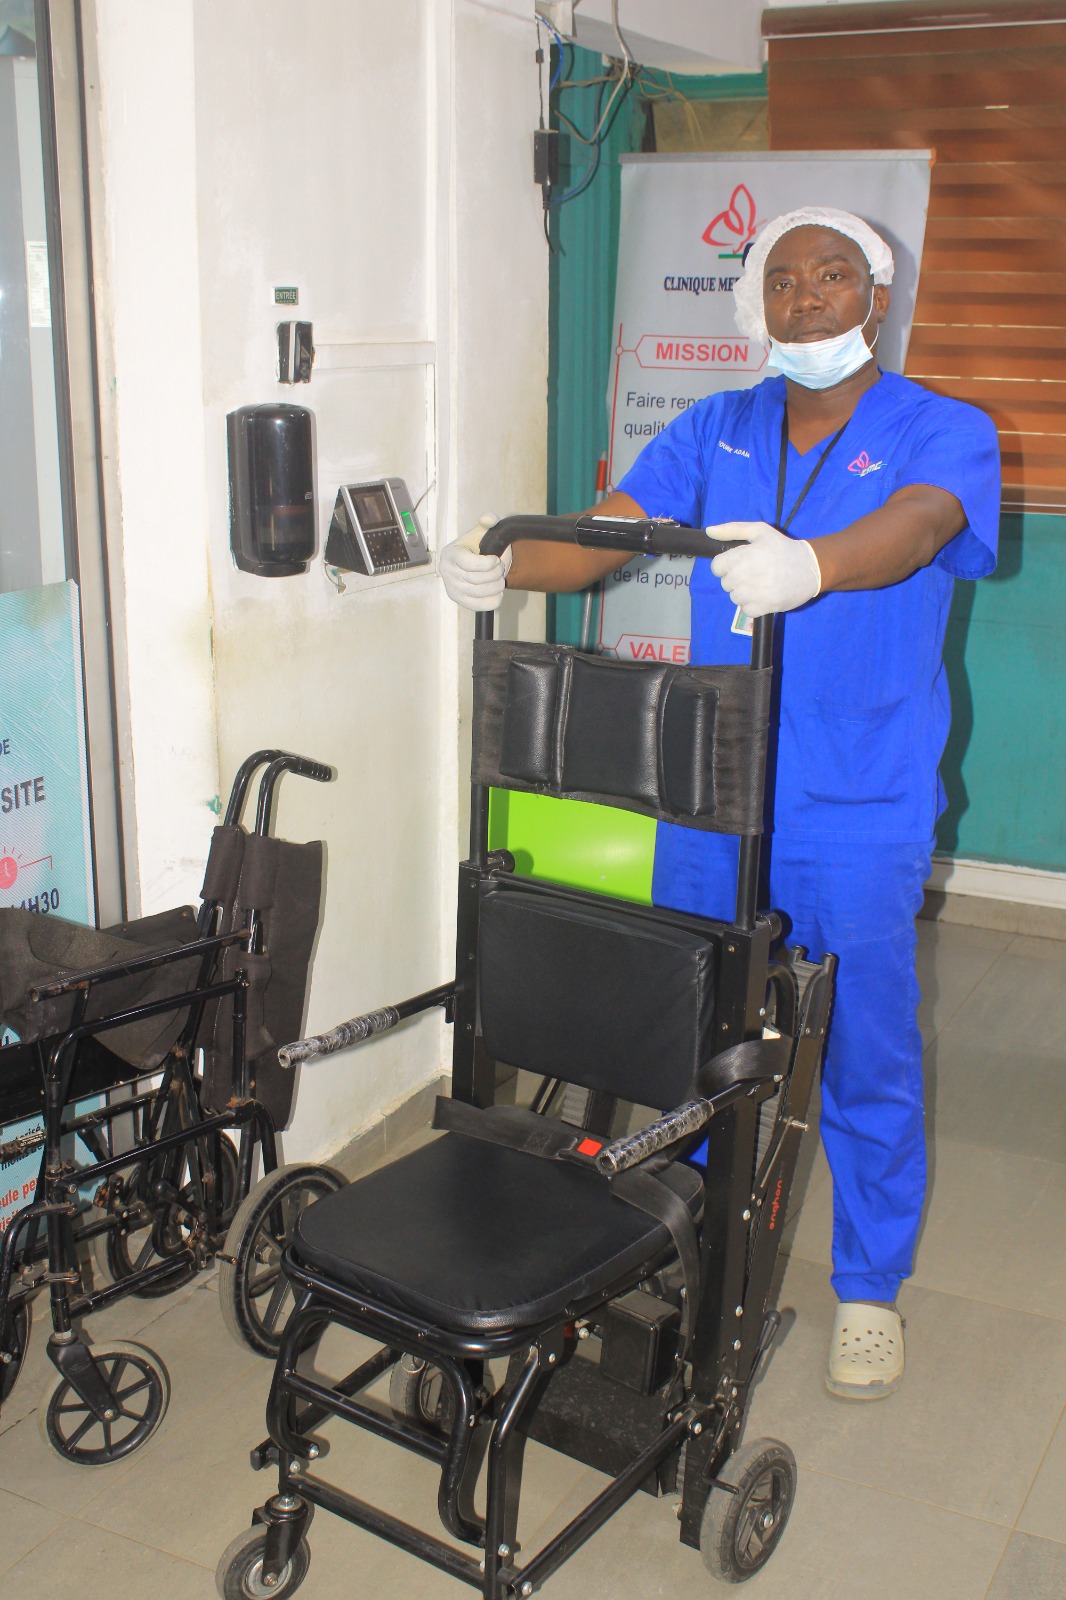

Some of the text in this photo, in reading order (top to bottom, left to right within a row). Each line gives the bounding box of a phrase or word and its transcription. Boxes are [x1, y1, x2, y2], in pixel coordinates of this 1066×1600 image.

[664, 276, 716, 296] CLINIQUE
[656, 343, 749, 362] MISSION
[626, 392, 665, 408] Faire
[613, 568, 632, 582] de
[636, 568, 649, 583] la
[629, 641, 691, 663] VALE
[1, 776, 46, 814] SITE
